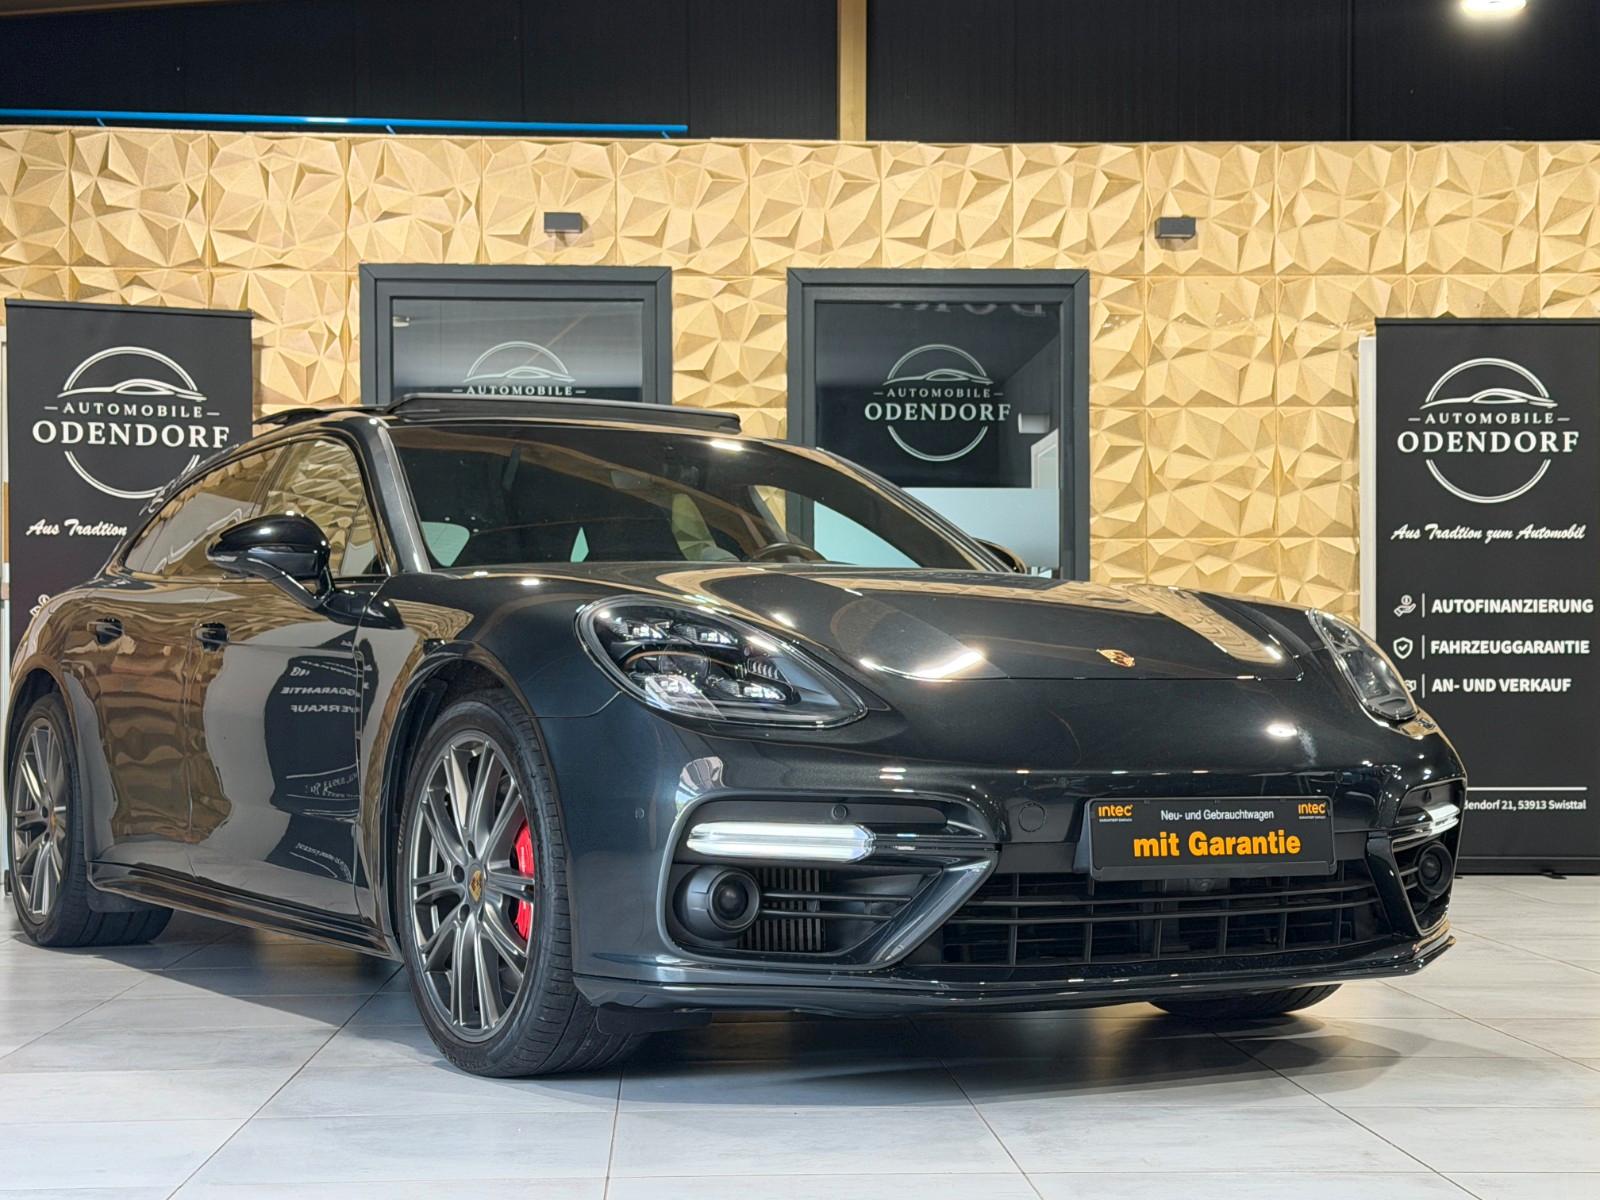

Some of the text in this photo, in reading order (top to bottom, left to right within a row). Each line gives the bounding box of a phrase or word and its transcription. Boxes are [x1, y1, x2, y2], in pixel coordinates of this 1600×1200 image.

[467, 384, 572, 396] AUTOMOBILE
[887, 387, 990, 398] AUTOMOBILE
[63, 402, 203, 418] AUTOMOBILE
[864, 403, 1011, 421] ODENDORF
[1425, 412, 1554, 424] AUTOMOBILE
[32, 420, 229, 448] ODENDORF
[1397, 431, 1580, 453] ODENDORF
[26, 518, 60, 536] Aus
[1390, 523, 1421, 540] Aus
[1484, 529, 1514, 544] zum
[1515, 523, 1587, 540] Automobil
[1431, 598, 1594, 614] AUTOFINANZIERUNG
[1430, 639, 1591, 655] FAHRZEUGGARANTIE
[1432, 678, 1573, 693] AN- UND VERKAUF
[1098, 804, 1133, 816] intec
[1298, 802, 1326, 815] intec
[1464, 799, 1587, 812] dendorf 21, 53913 Swisttal
[1161, 809, 1275, 821] Neu- und Gebrauchtwagen
[1133, 830, 1301, 858] mit Garantie
